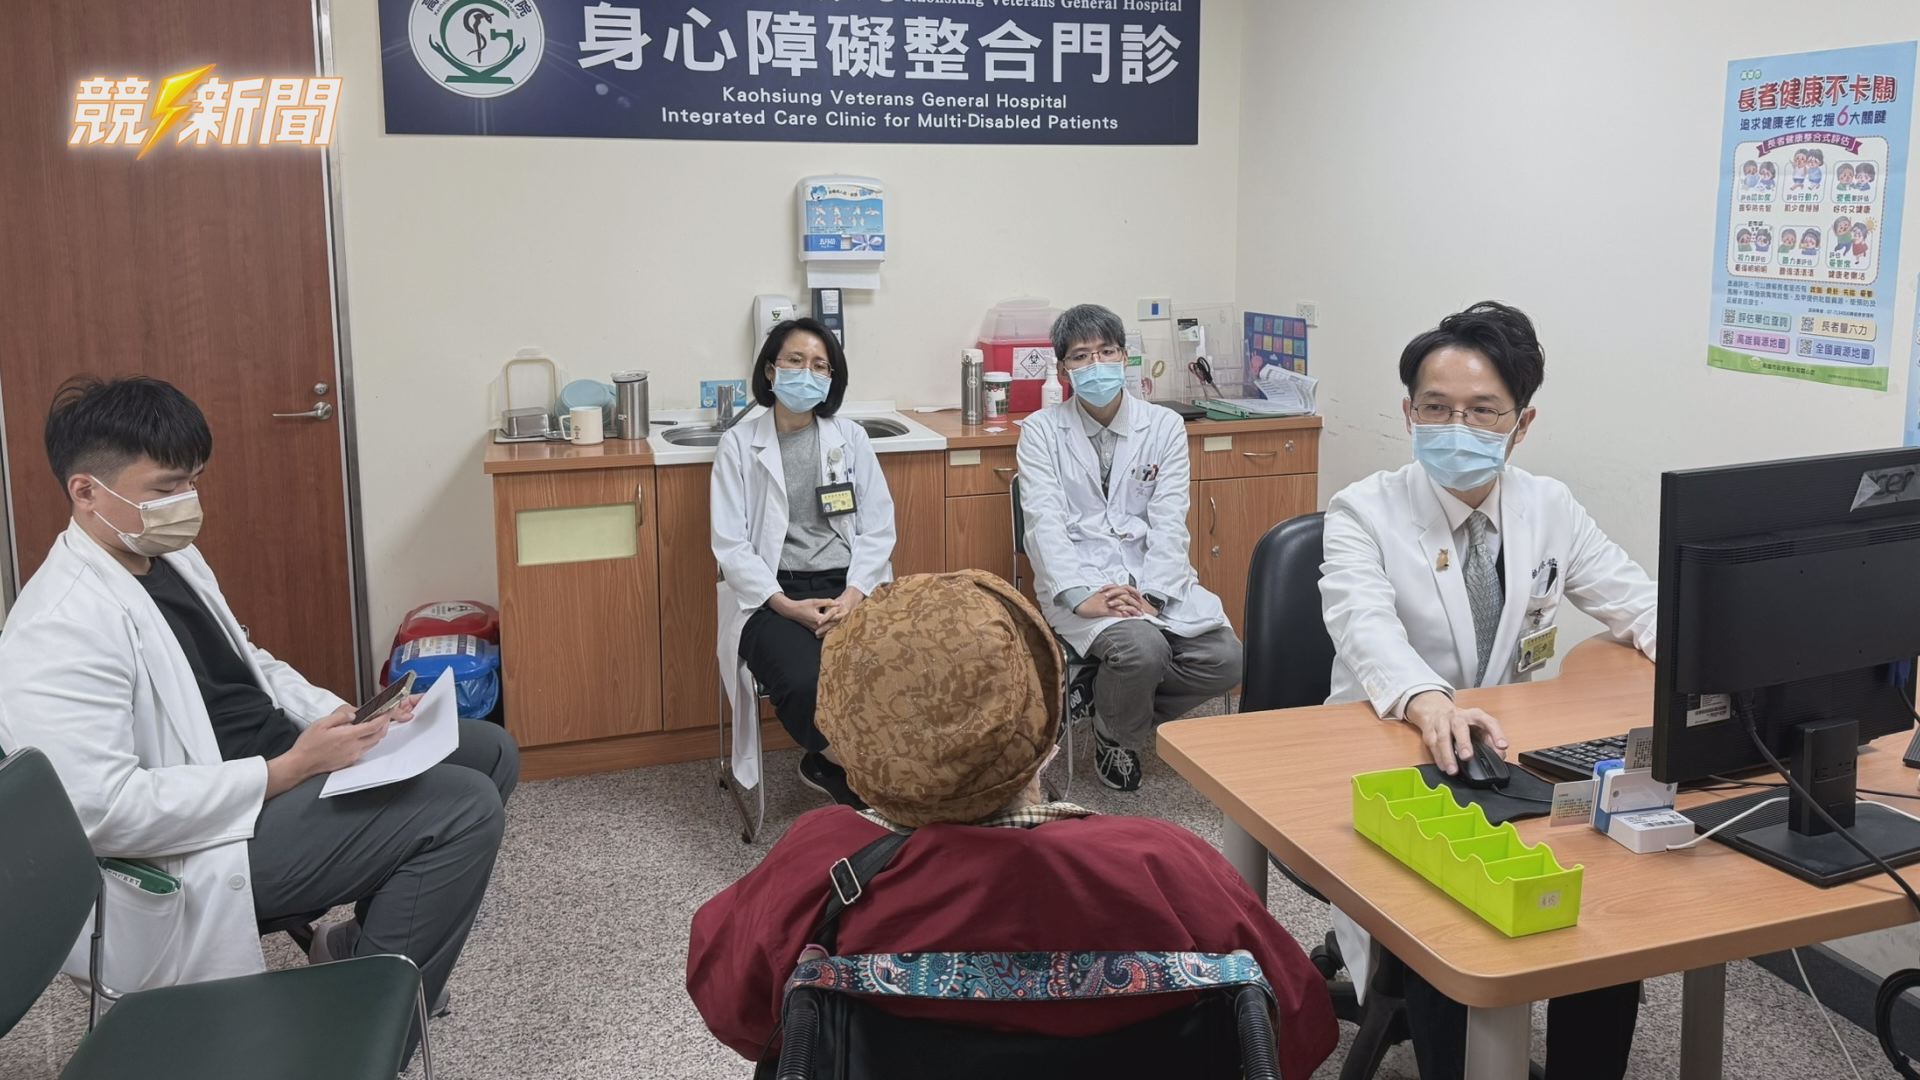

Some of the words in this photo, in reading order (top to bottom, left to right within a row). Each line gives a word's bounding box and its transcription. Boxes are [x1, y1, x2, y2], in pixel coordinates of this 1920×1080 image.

[1123, 0, 1182, 13] Hospital
[578, 3, 1182, 85] 身心障礙整合門診
[722, 86, 822, 106] Kaohsiung
[830, 90, 914, 106] Veterans
[922, 92, 989, 107] General
[997, 93, 1067, 110] Hospital
[1738, 74, 1897, 112] 長者健康不卡關
[662, 107, 766, 125] Integrated
[774, 110, 818, 125] Care
[826, 111, 877, 126] Clinic
[884, 113, 910, 127] for
[918, 113, 1041, 129] Multi-Disabled
[1048, 115, 1118, 129] Patients
[1740, 114, 1807, 131] 追求健康老化
[1811, 105, 1887, 128] 把握6大關鍵
[1767, 132, 1850, 148] 長者健康整合式評估
[1822, 321, 1867, 336] 長者量六力
[1871, 470, 1915, 497] cer
